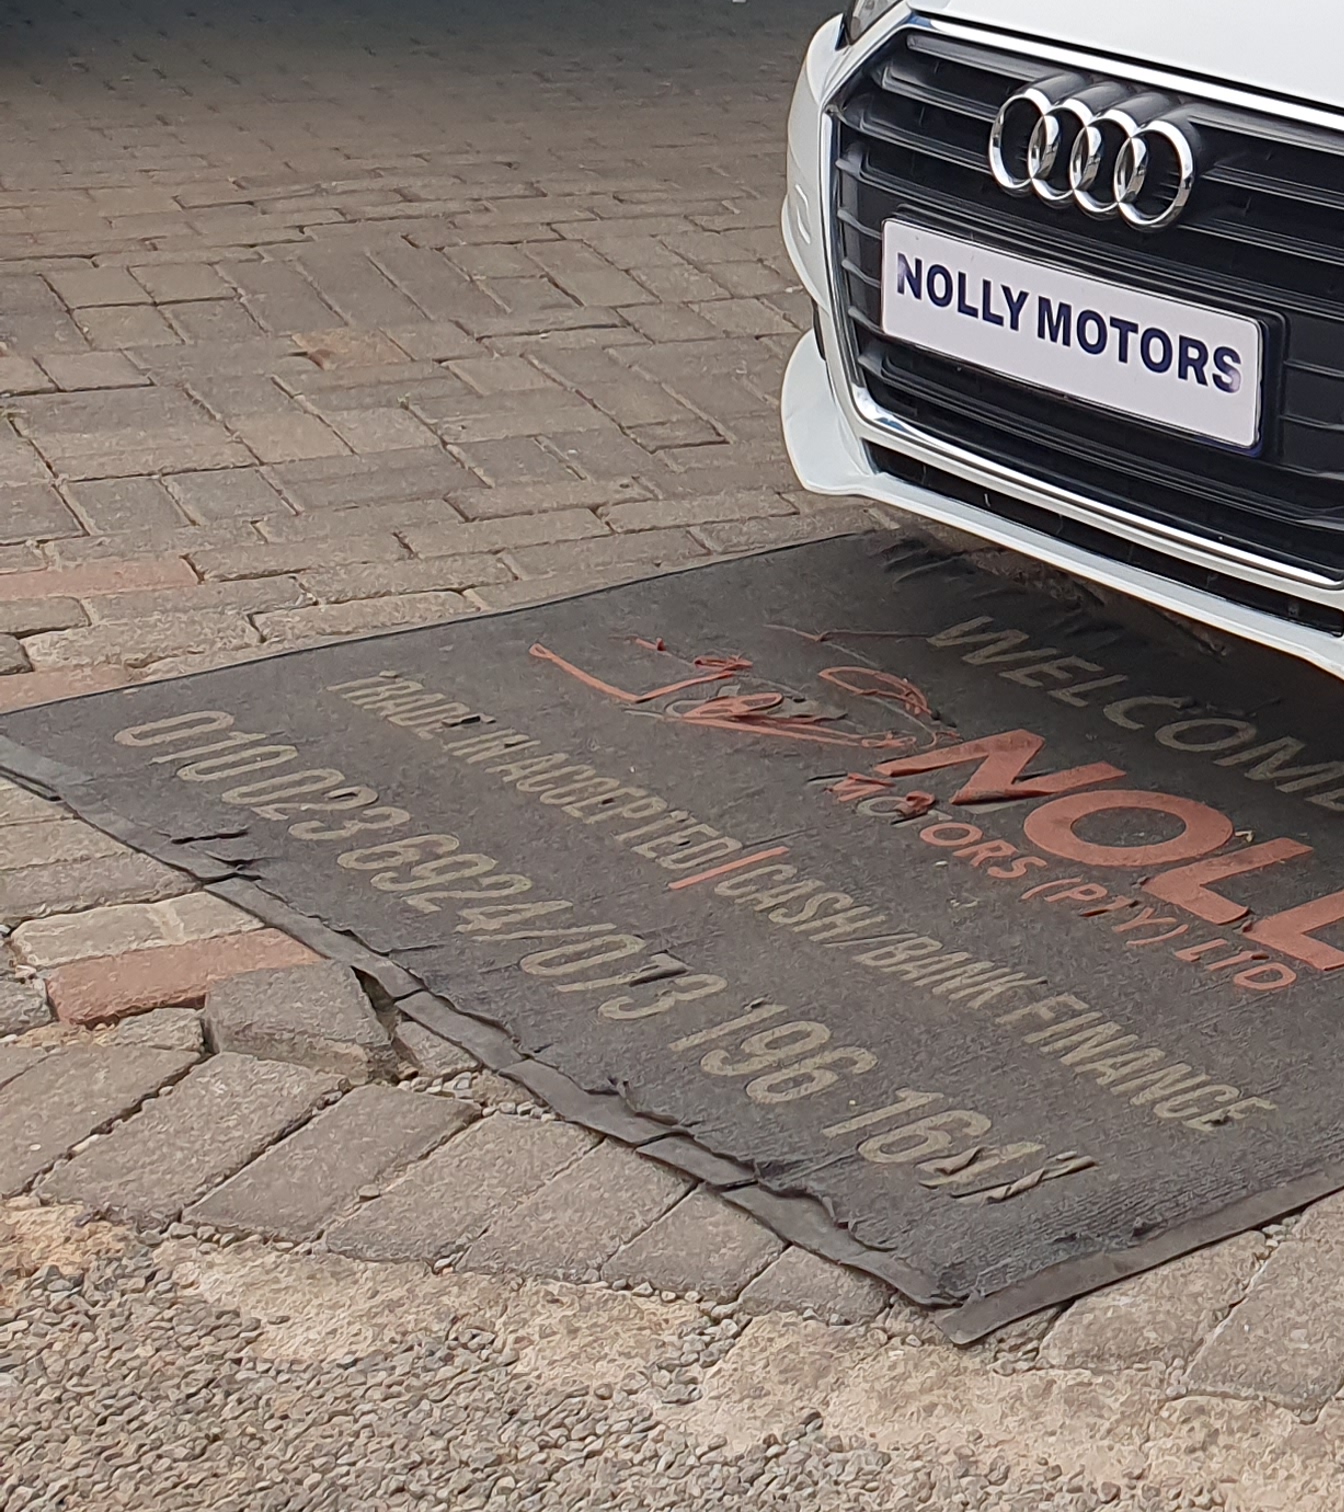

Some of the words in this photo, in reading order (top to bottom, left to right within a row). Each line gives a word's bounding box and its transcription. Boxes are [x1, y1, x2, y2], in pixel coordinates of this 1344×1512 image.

[896, 253, 1029, 334] NOLLY
[1037, 297, 1243, 394] MOTORS
[113, 709, 300, 782] 010
[221, 767, 411, 841] 023
[667, 998, 879, 1104] 196
[326, 669, 496, 740] TRADE
[442, 727, 542, 764] IN
[997, 992, 1278, 1132] FINANCE
[1174, 938, 1297, 990] LTD
